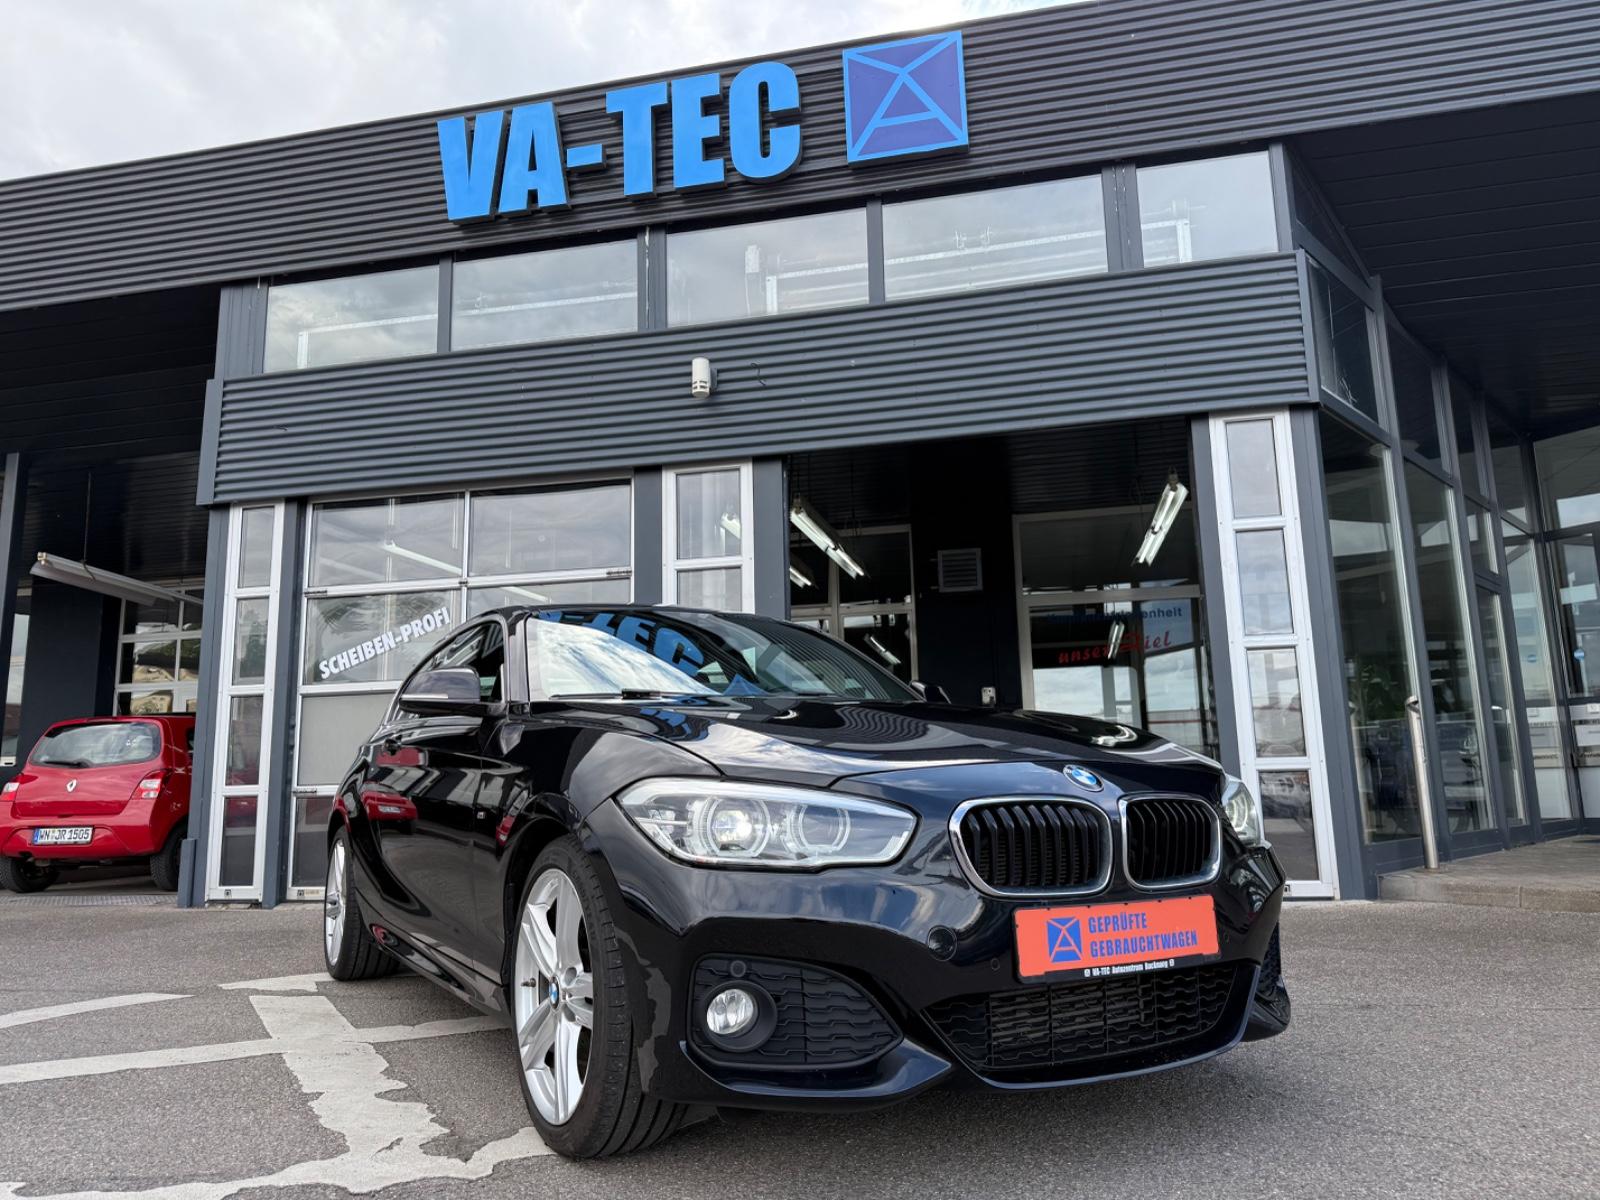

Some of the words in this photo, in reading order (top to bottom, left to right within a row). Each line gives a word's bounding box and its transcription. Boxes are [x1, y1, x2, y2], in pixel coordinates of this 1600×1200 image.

[437, 61, 801, 222] VA-TEC
[319, 607, 450, 679] SCHEIBEN-PROFI
[68, 829, 90, 840] 1505
[1088, 912, 1147, 934] GEPRÜFTE
[1090, 930, 1198, 958] GEBRAUCHTWAGEN
